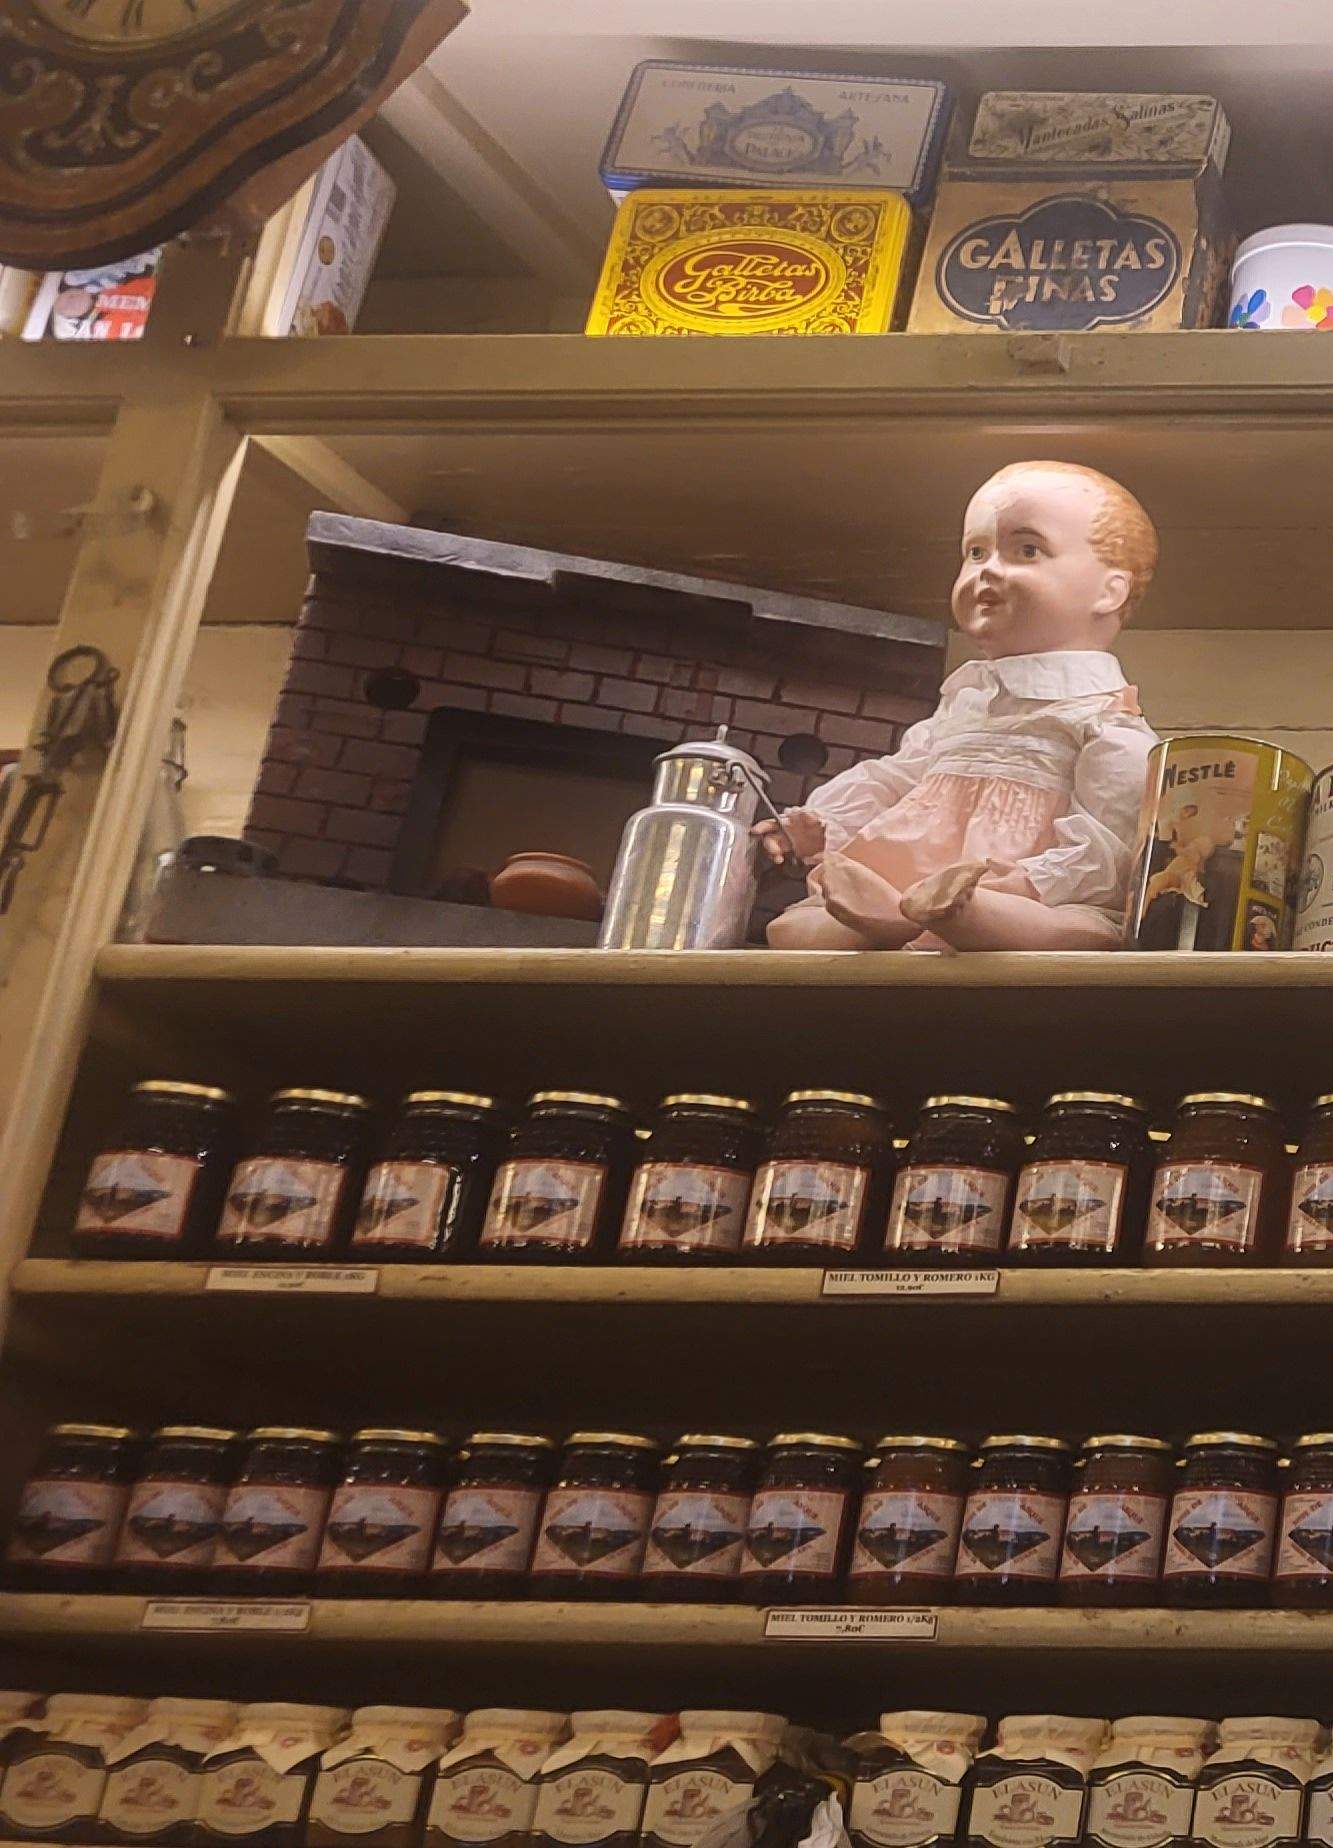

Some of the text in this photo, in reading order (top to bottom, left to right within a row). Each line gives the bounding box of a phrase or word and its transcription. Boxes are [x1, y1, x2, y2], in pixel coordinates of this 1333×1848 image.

[959, 229, 1168, 270] GALLETAS
[674, 250, 819, 293] Galletas
[686, 275, 803, 308] Birba
[1163, 759, 1236, 792] NESTLÉ
[829, 1273, 857, 1282] MIEL
[859, 1273, 911, 1283] TOMILLO
[924, 1273, 972, 1283] ROMERO
[771, 1613, 797, 1622] MIEL
[800, 1613, 850, 1623] TOMILLO
[859, 1613, 904, 1623] ROMERO
